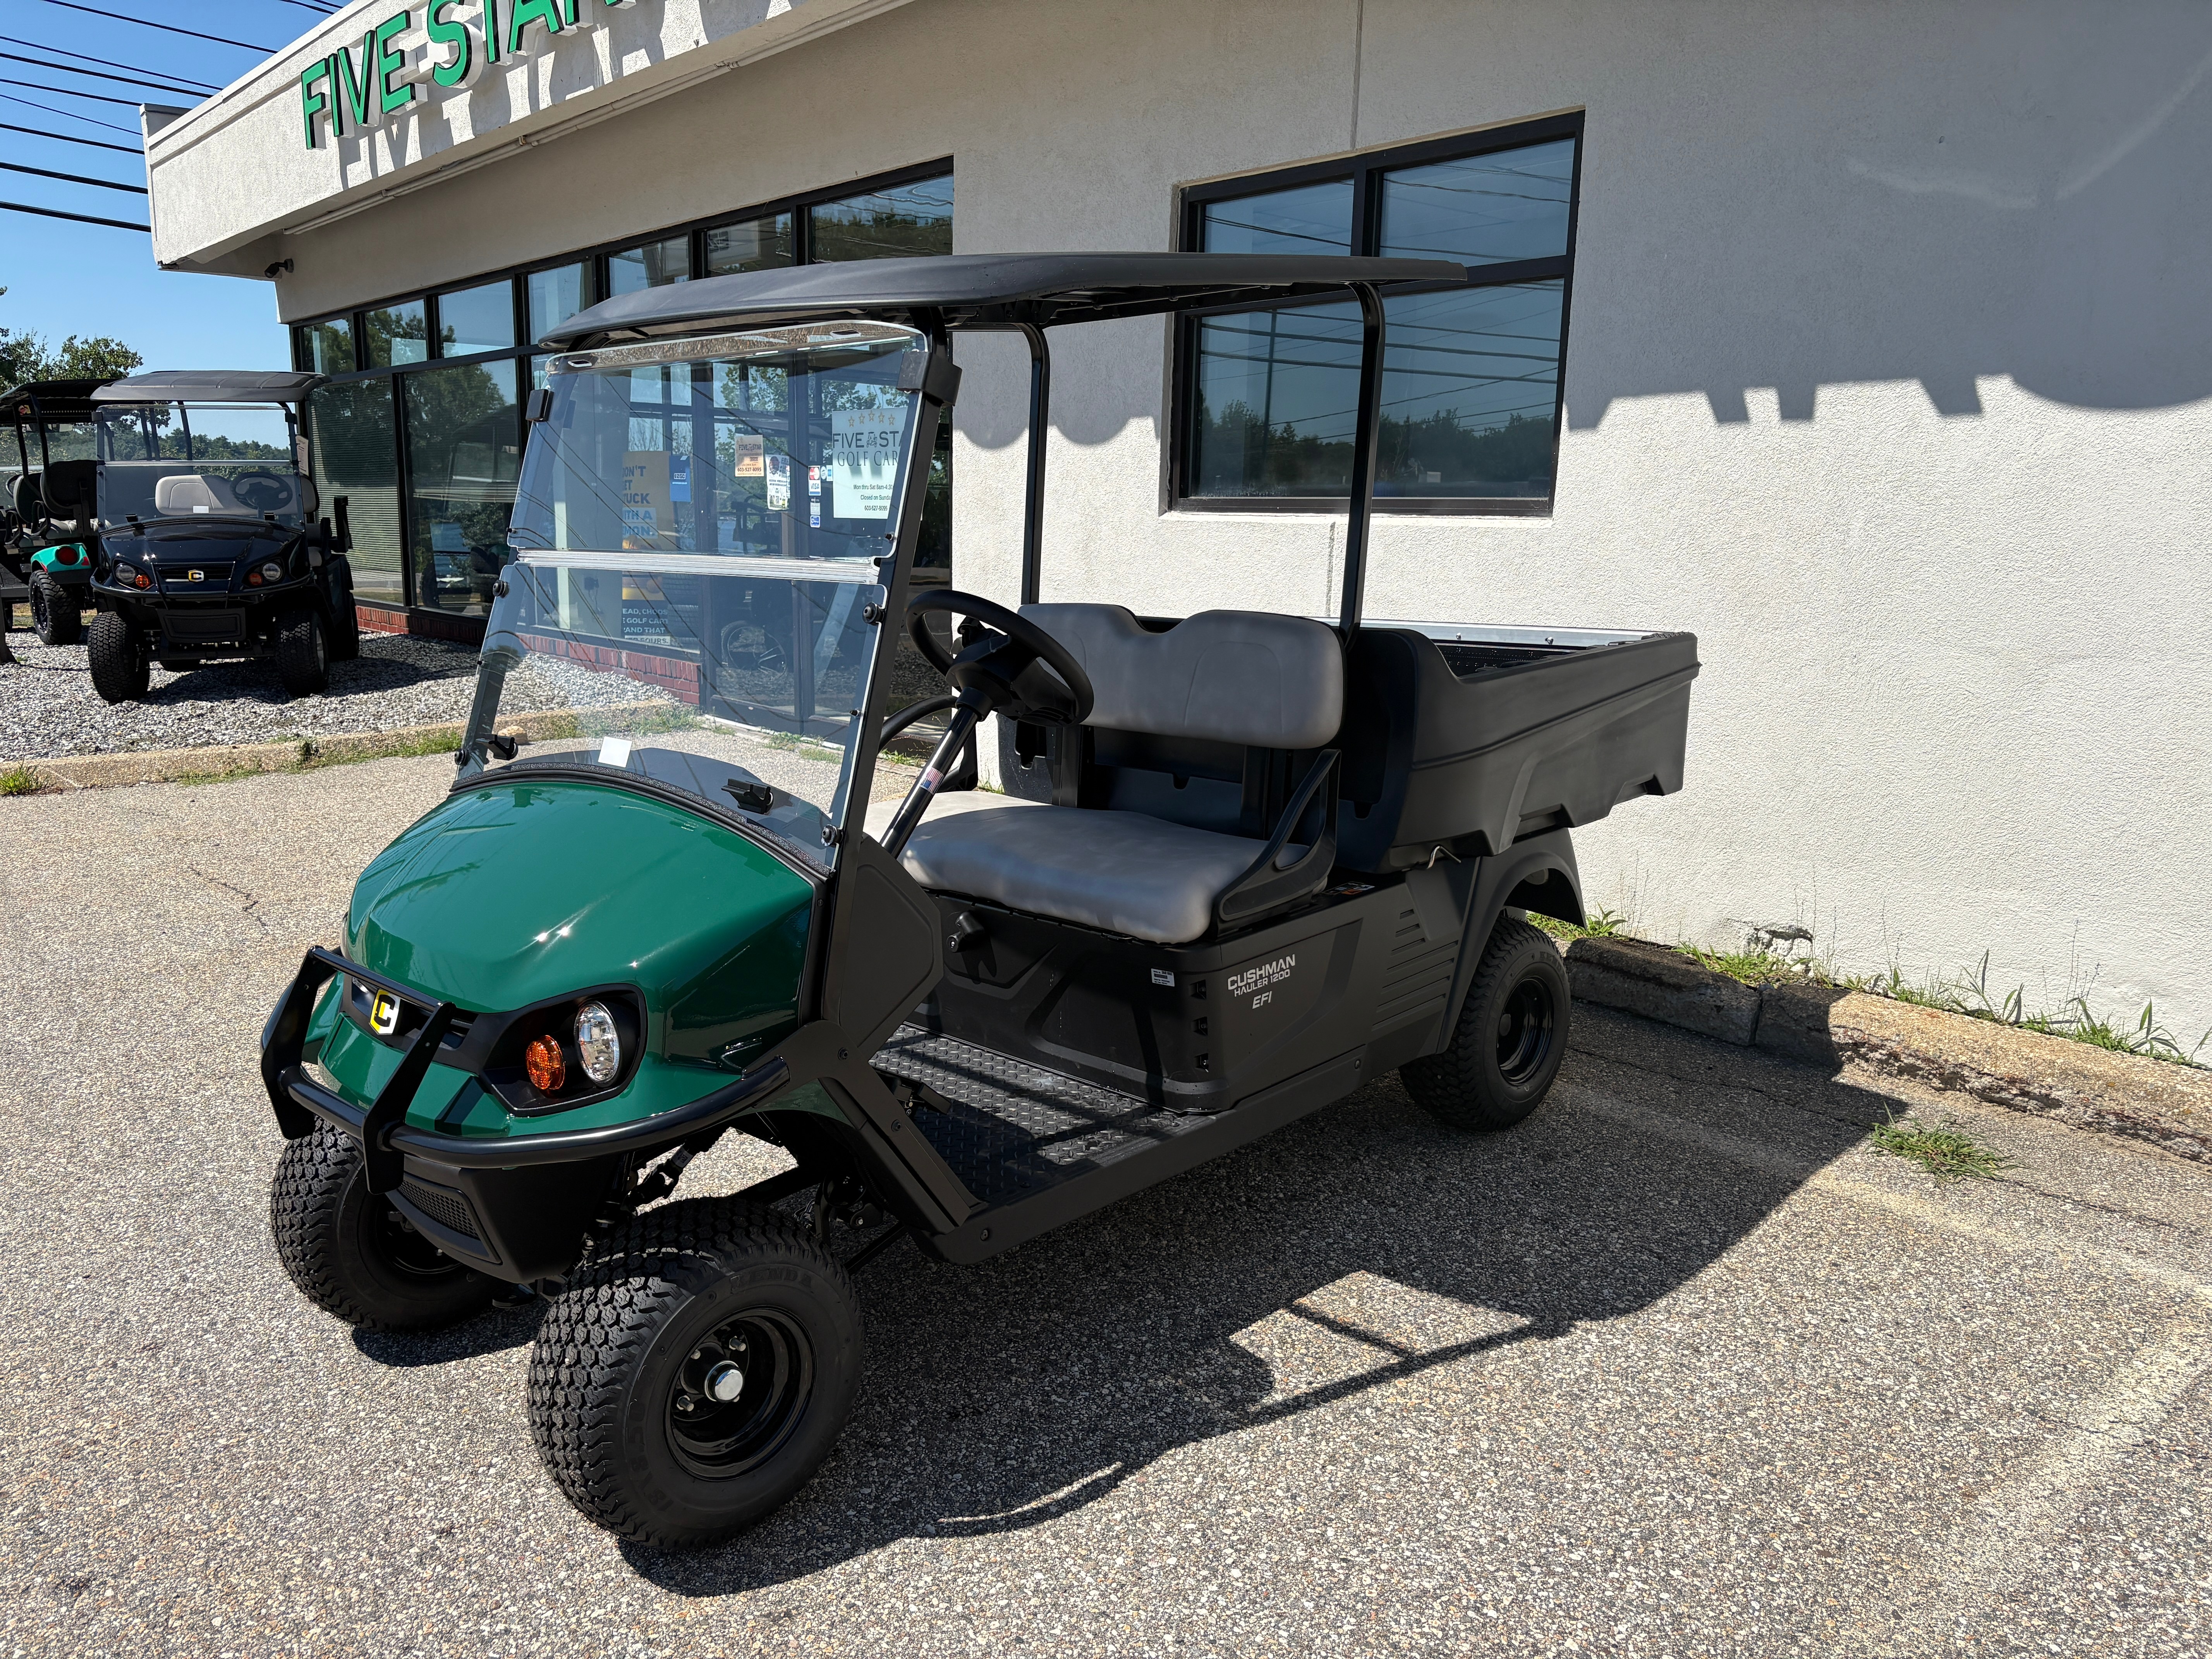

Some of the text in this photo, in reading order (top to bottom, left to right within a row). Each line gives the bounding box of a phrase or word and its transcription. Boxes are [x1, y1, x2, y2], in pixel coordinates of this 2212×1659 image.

[301, 0, 620, 150] FIVE STA
[833, 431, 903, 449] FIVE ST
[837, 451, 868, 467] GOLF
[643, 510, 653, 520] A
[1227, 954, 1296, 991] CUSHMAN
[1234, 969, 1290, 997] HAULER 1200
[1252, 991, 1273, 1009] EFI
